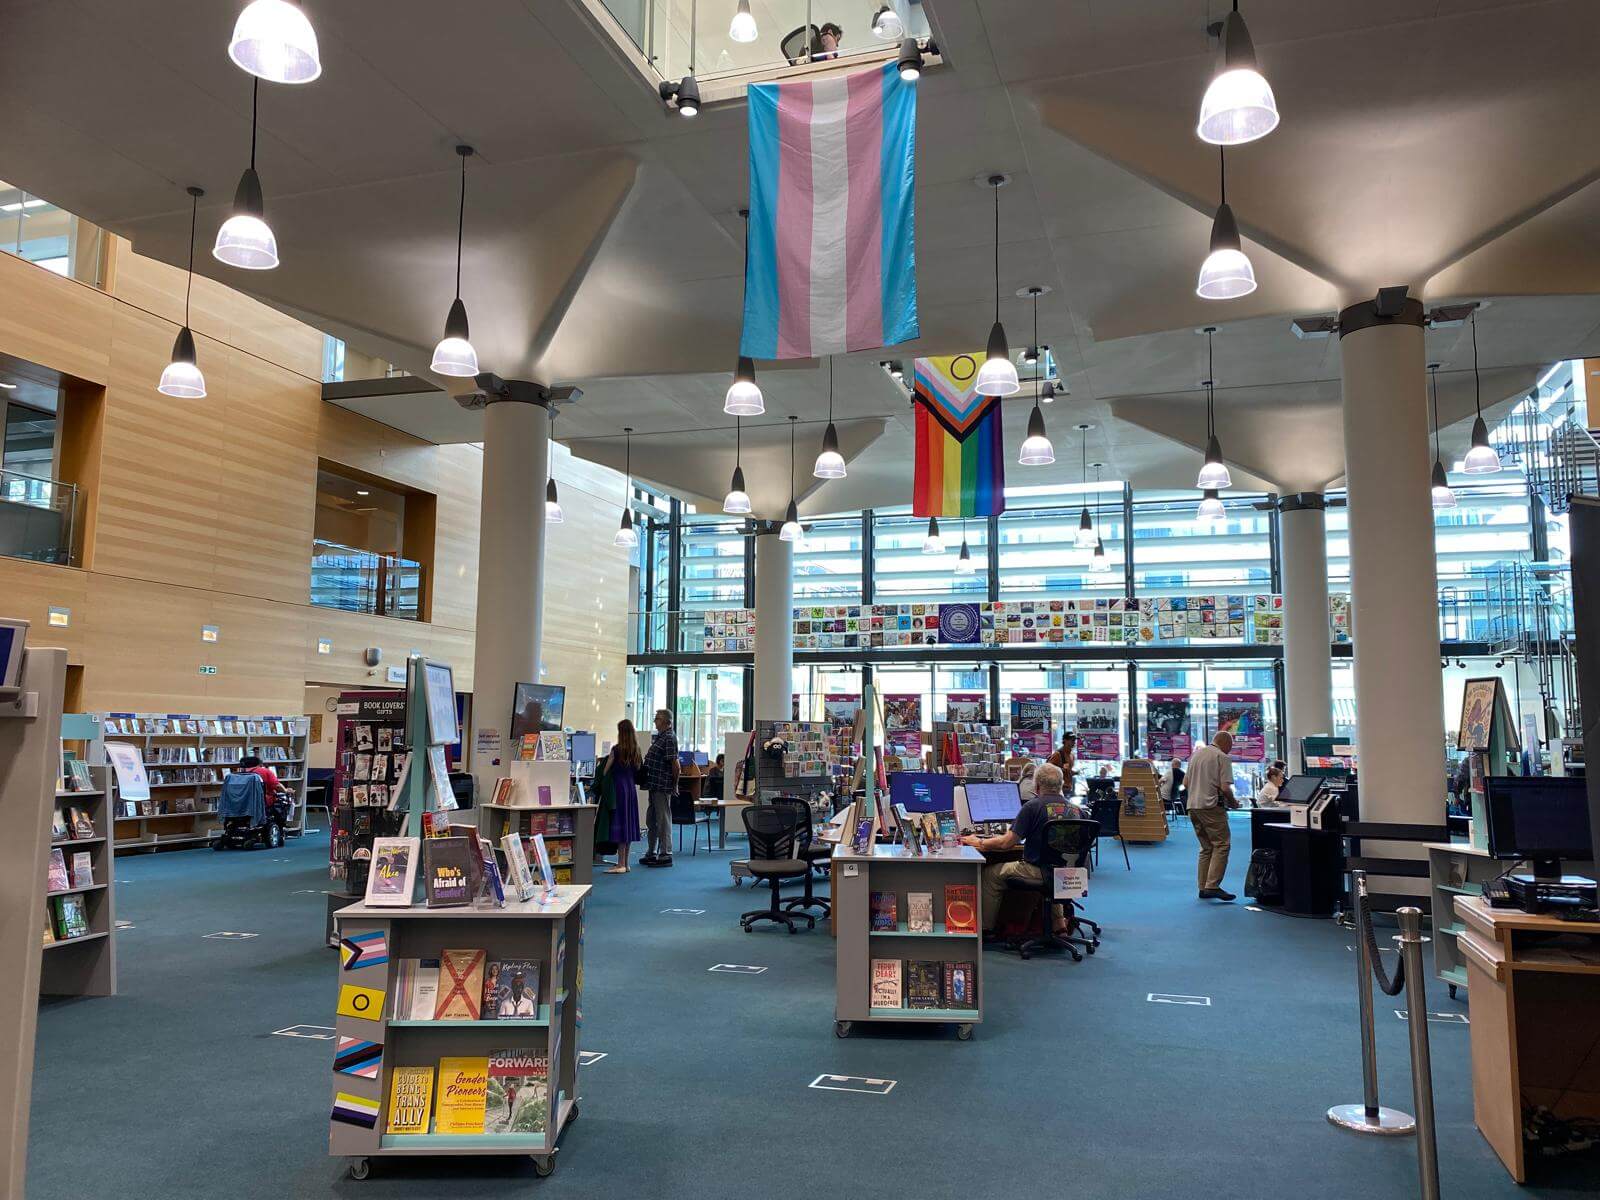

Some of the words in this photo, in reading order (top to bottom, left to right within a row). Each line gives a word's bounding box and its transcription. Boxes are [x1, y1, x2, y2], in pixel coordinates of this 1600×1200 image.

[437, 867, 461, 877] Who's
[433, 878, 457, 888] Afraid
[458, 877, 466, 886] of
[488, 1057, 548, 1068] FORWARD
[398, 1074, 421, 1084] GUIDE
[422, 1076, 429, 1084] TO
[455, 1072, 486, 1084] Gender
[396, 1085, 420, 1095] BEING
[422, 1085, 427, 1094] A
[446, 1085, 486, 1098] Pioneers
[395, 1096, 426, 1108] TRANS
[393, 1108, 424, 1126] ALLY
